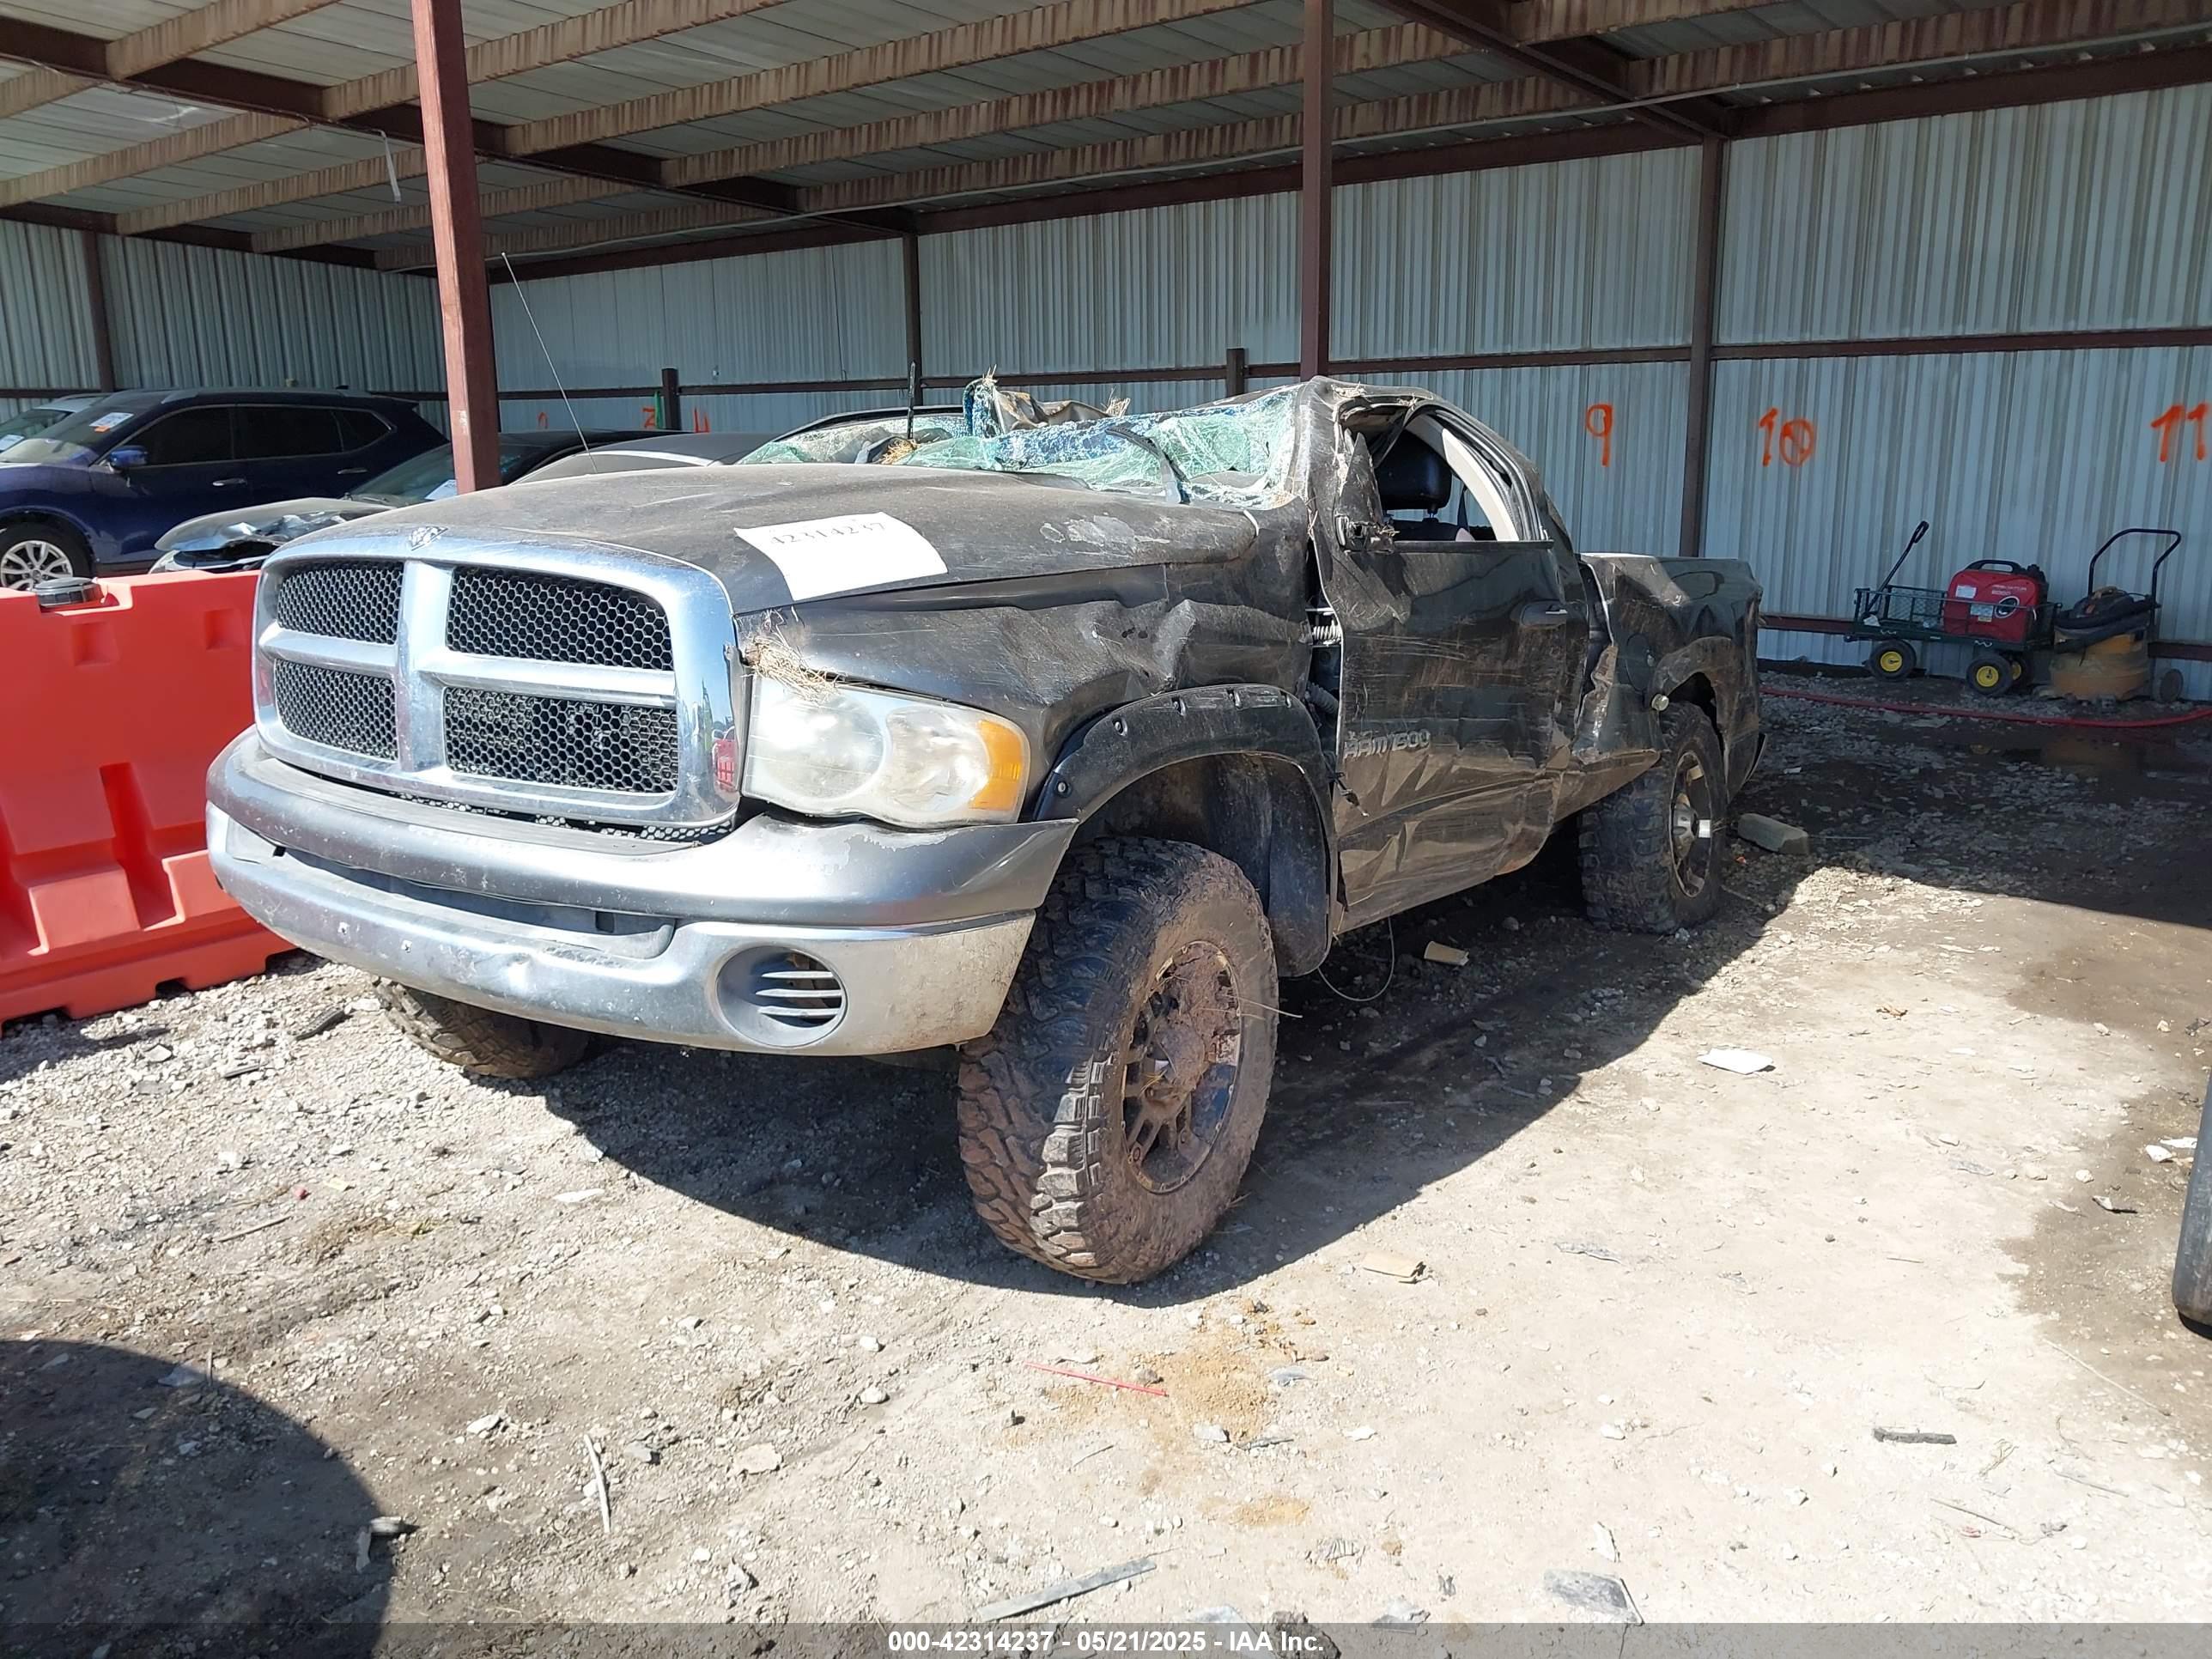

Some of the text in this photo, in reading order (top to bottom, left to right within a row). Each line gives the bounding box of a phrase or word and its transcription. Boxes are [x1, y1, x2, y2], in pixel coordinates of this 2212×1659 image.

[1586, 404, 1613, 466] 9
[1759, 408, 1816, 466] 10
[2150, 403, 2210, 462] 11
